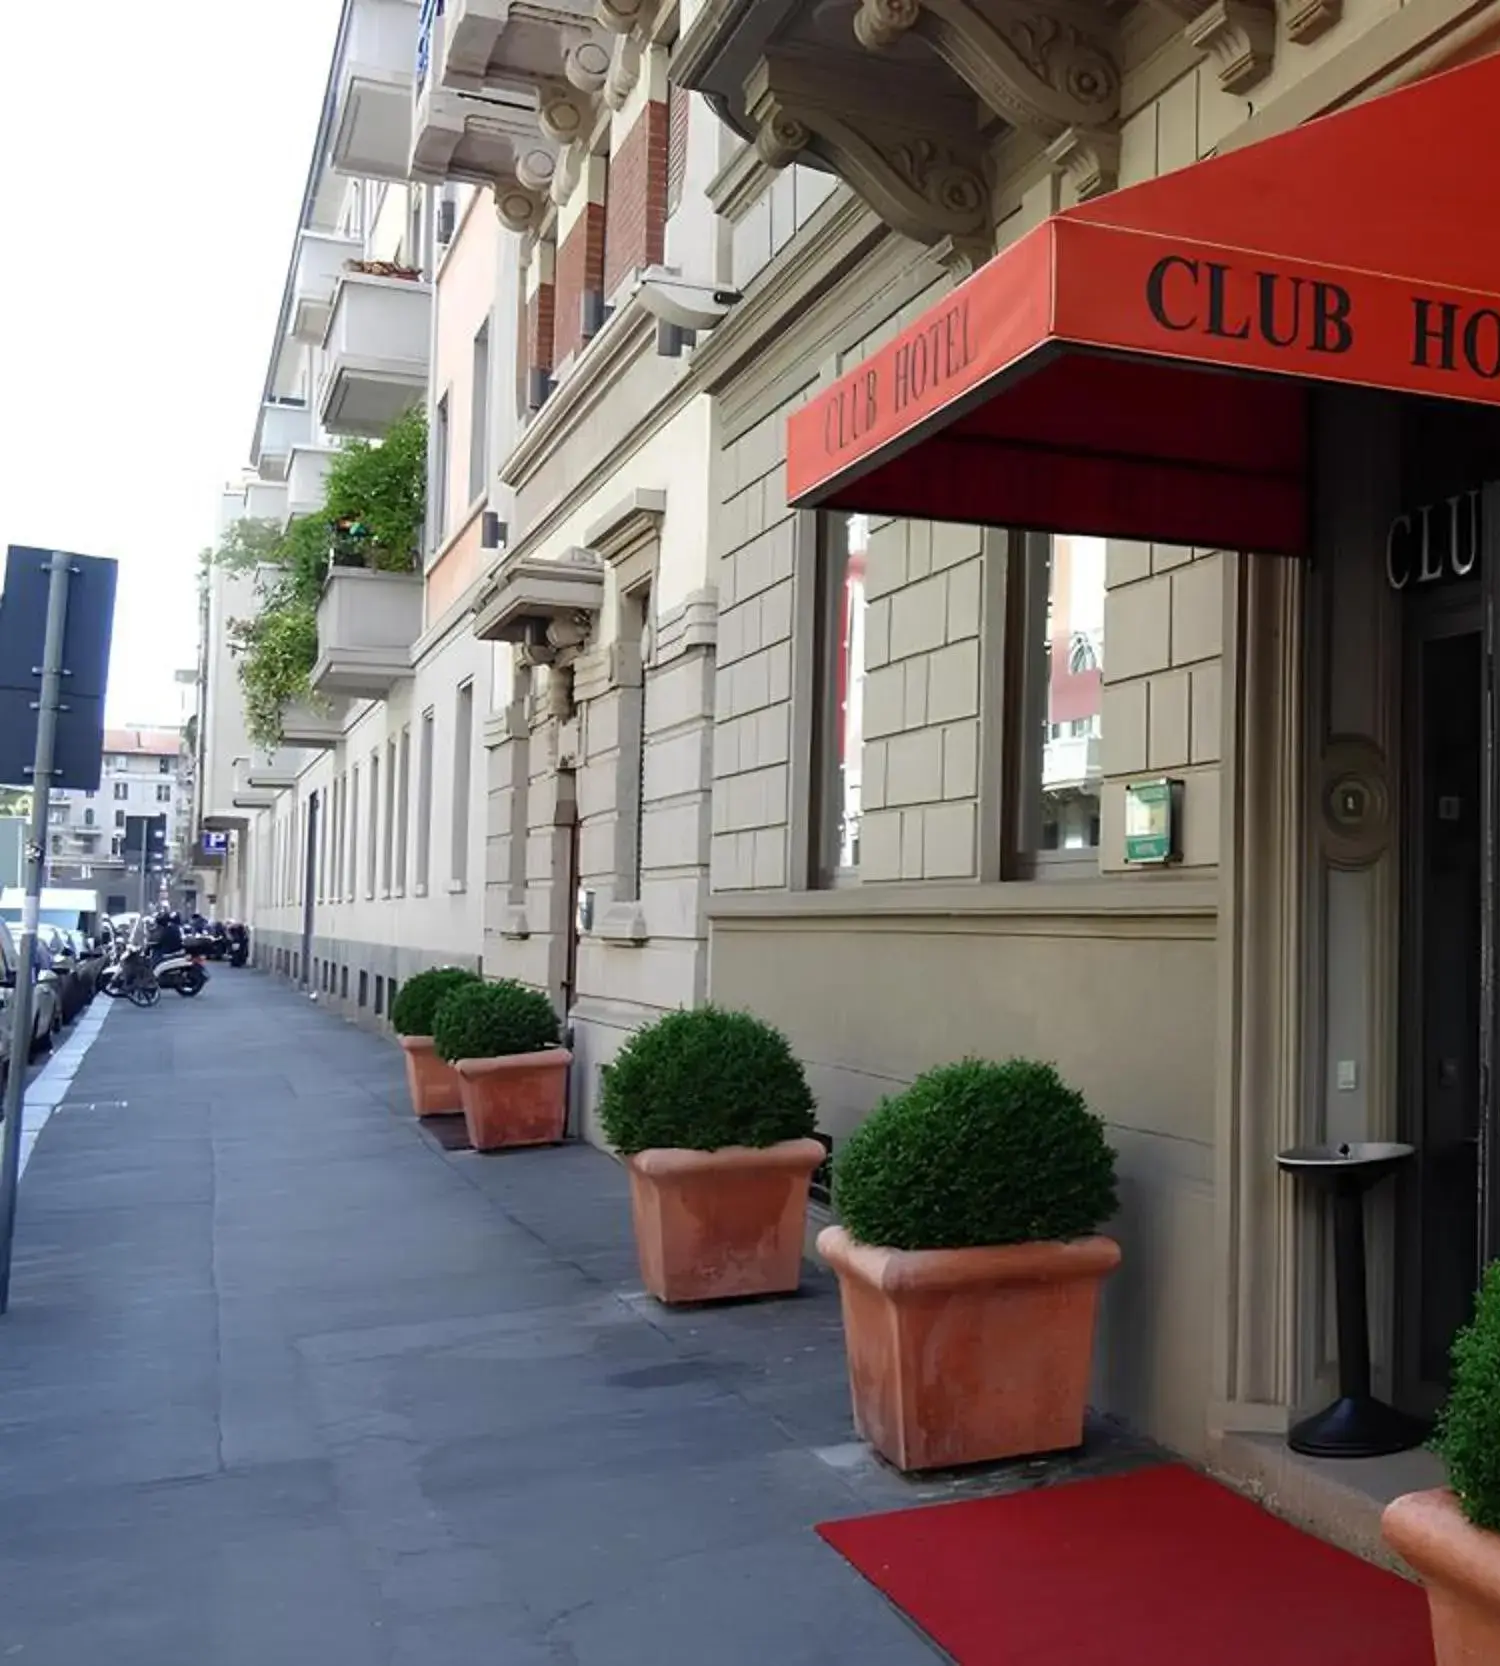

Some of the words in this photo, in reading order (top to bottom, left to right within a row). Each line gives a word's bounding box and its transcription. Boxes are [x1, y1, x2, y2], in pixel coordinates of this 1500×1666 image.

[1145, 255, 1354, 355] CLUB
[824, 369, 877, 457] CLUB
[894, 297, 978, 414] HOTEL
[1386, 489, 1480, 590] CLU
[209, 832, 226, 847] P
